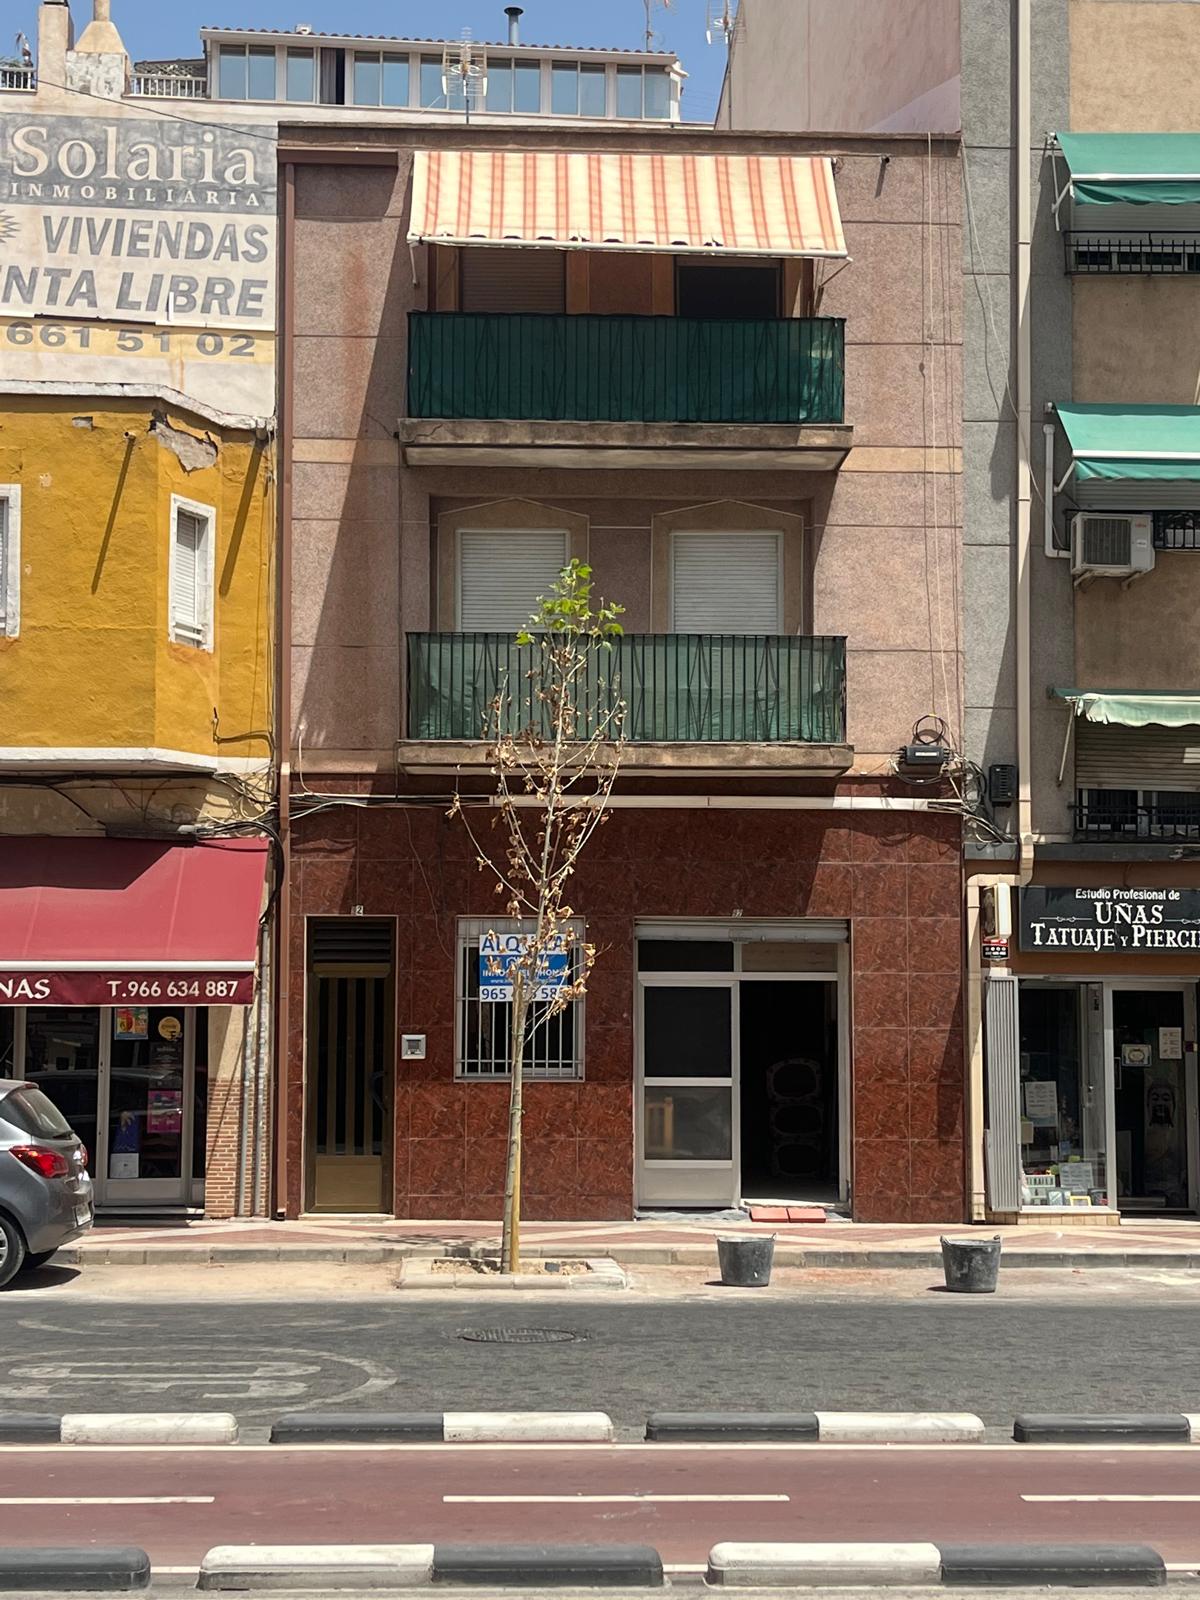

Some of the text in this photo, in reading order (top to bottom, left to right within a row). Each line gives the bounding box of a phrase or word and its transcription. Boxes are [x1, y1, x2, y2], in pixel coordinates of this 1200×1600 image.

[12, 126, 259, 186] Solaria
[11, 182, 260, 207] INMOBILIARIA
[43, 215, 269, 263] VIVIENDAS
[0, 265, 268, 318] NTA LIBRE
[7, 321, 255, 357] 661 51 02
[1075, 888, 1181, 901] Estudio Profesional de
[1094, 901, 1164, 925] UÑAS
[481, 935, 564, 953] ALQA
[1031, 922, 1116, 951] TATUAJE
[1131, 924, 1200, 949] PIERCI
[106, 980, 161, 997] T.966
[167, 980, 199, 997] 634
[205, 980, 238, 997] 887
[481, 987, 507, 1000] 965
[541, 987, 564, 999] 58
